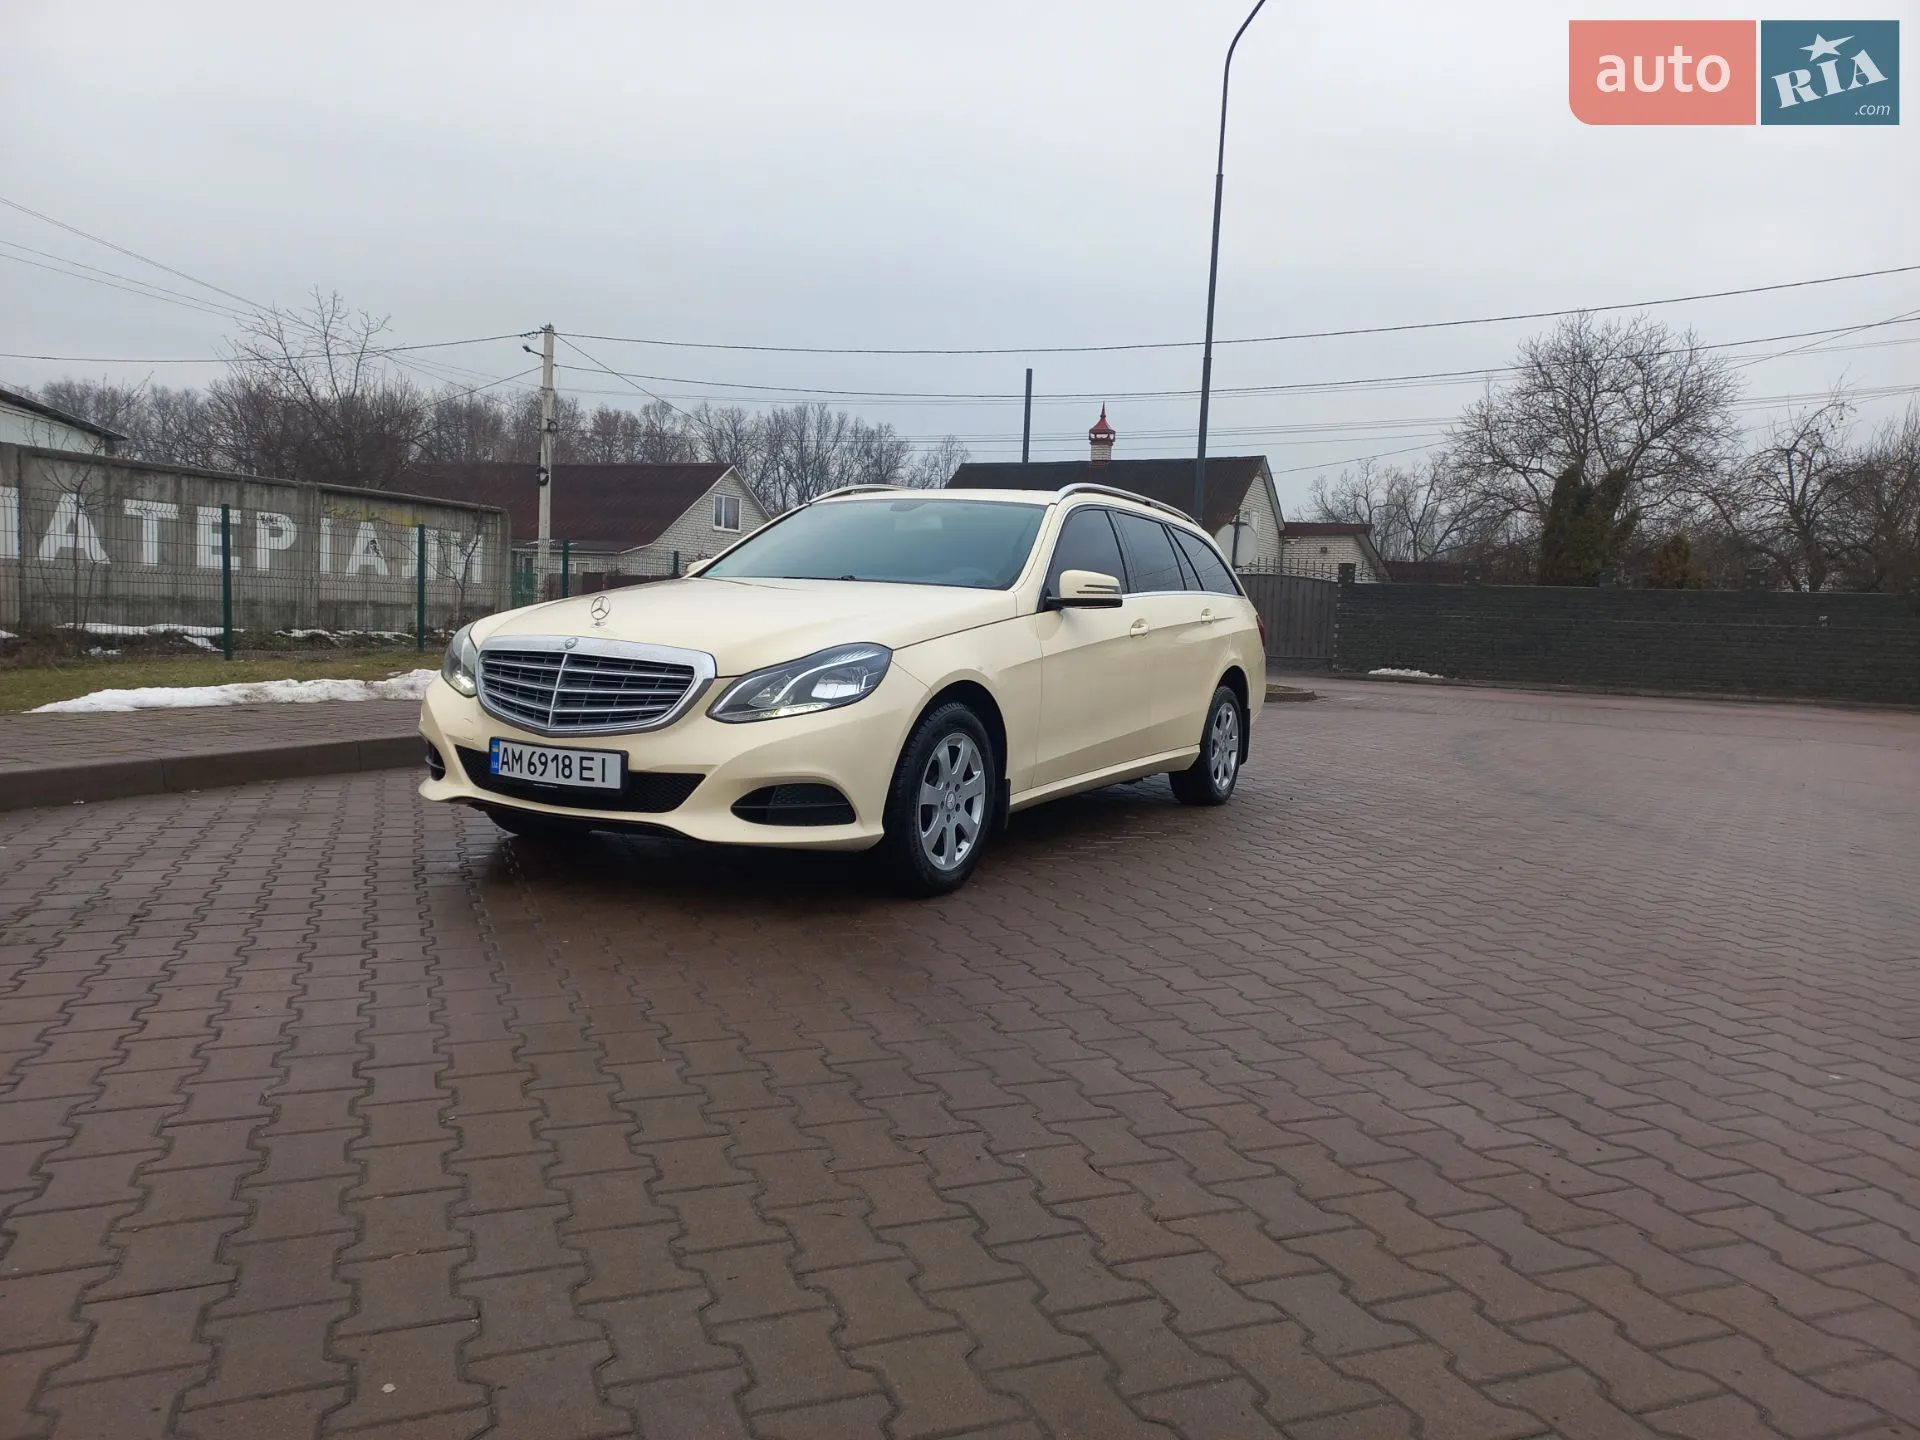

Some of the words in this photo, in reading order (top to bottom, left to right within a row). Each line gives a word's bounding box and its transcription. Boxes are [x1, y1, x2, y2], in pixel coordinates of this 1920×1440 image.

[501, 747, 523, 774] AM
[527, 751, 573, 780] 6918
[579, 756, 606, 783] EI
